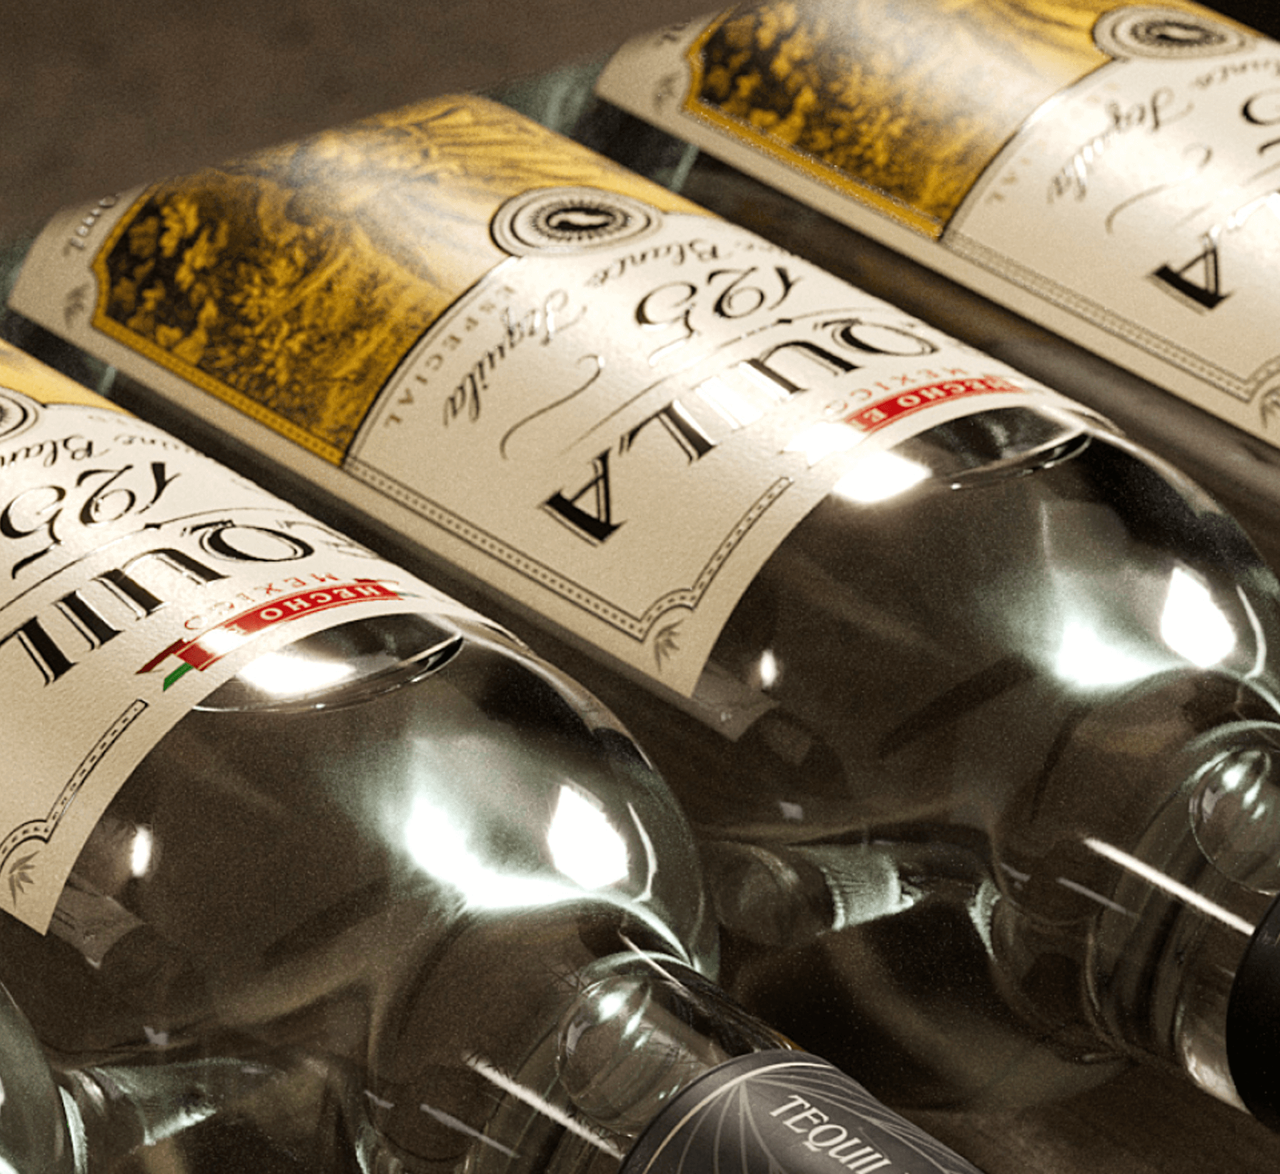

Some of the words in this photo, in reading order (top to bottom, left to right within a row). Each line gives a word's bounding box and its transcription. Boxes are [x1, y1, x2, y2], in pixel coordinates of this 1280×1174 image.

[635, 266, 807, 367] 125
[183, 572, 340, 631] MEXICO
[260, 583, 383, 622] HECHO
